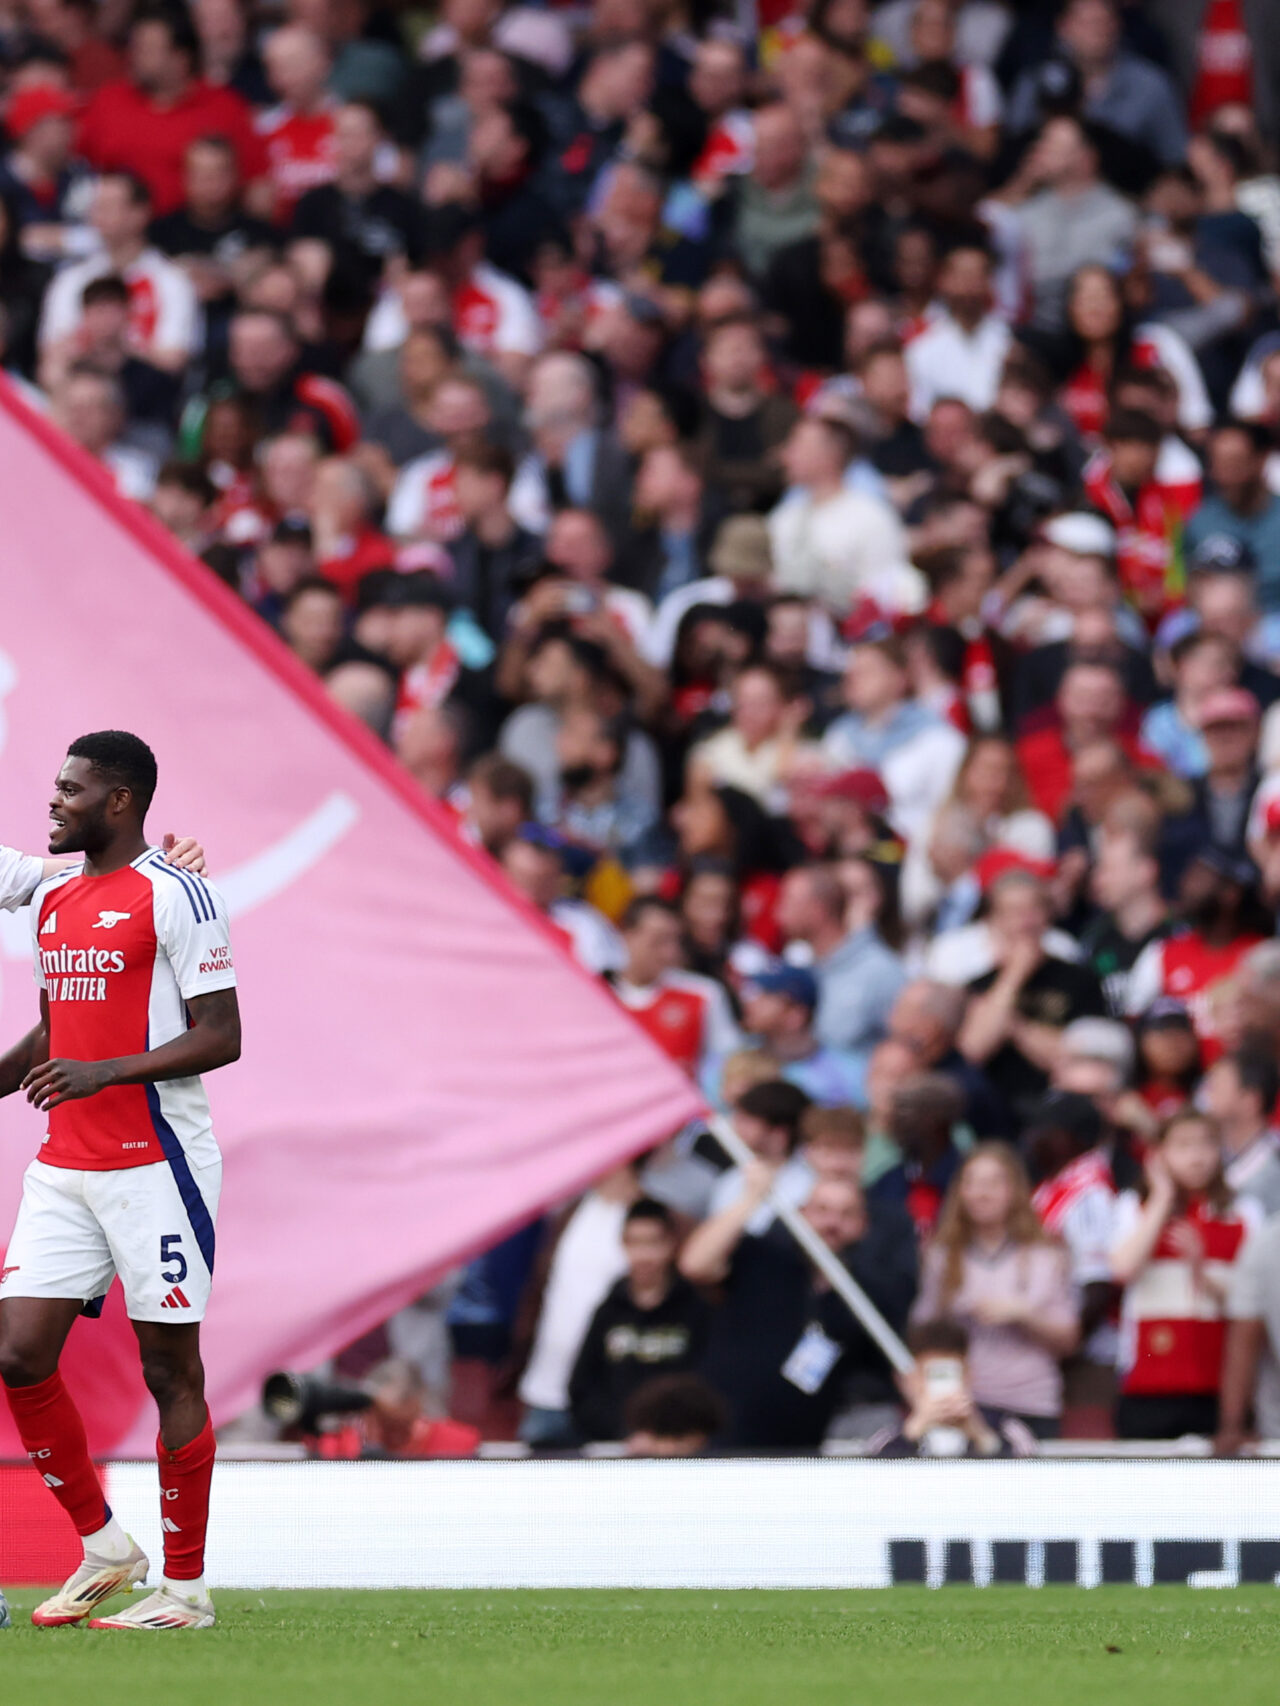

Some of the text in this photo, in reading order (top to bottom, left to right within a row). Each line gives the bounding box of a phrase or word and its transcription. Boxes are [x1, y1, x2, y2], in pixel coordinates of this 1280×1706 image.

[39, 943, 125, 974] mirates
[209, 946, 228, 959] VIS
[199, 958, 233, 974] RWAN
[60, 977, 106, 1001] BETTER
[160, 1234, 188, 1284] 5
[28, 1448, 52, 1459] FC
